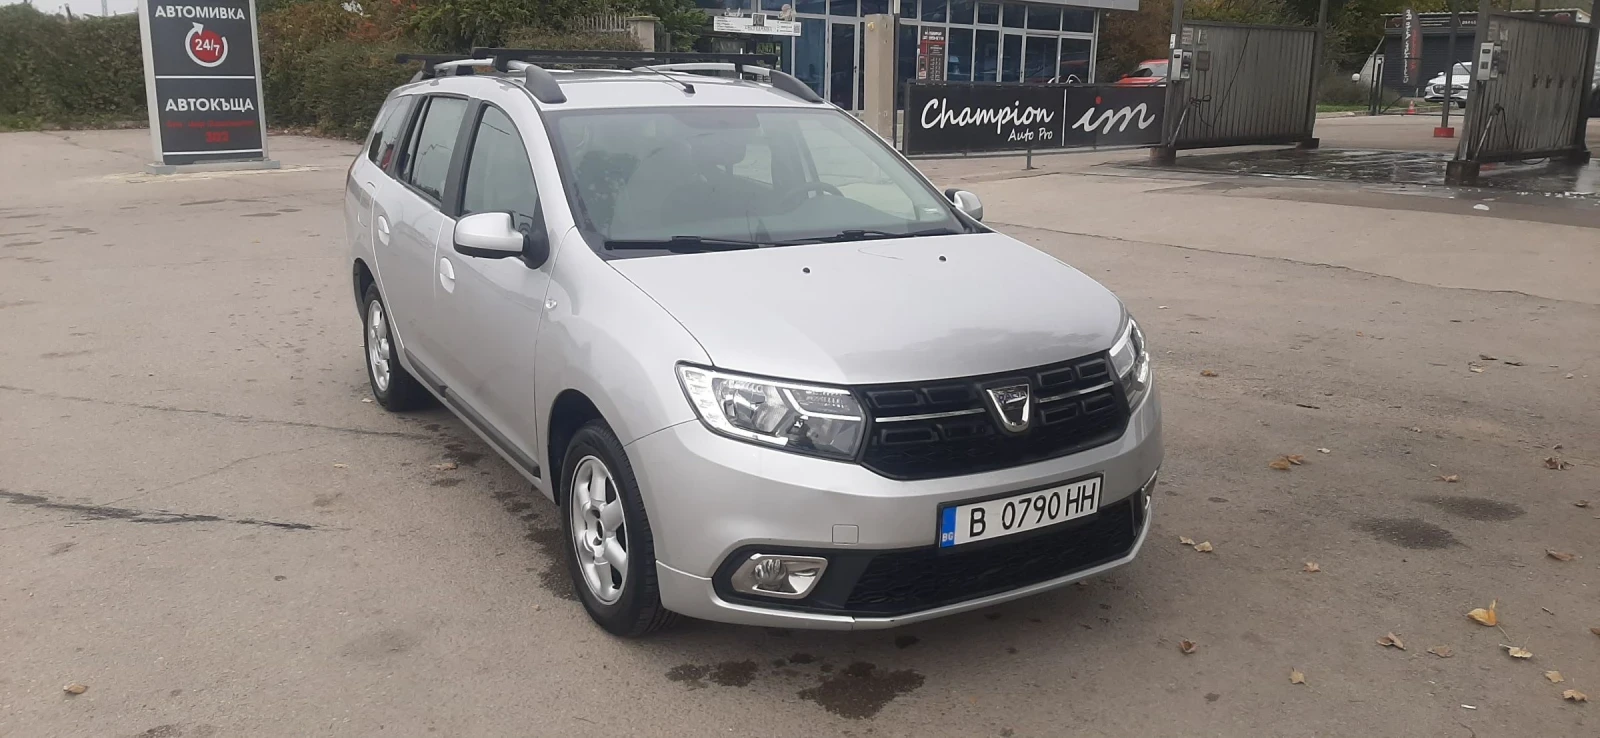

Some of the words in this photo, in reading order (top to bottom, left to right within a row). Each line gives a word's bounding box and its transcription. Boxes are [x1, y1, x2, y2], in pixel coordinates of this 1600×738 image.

[155, 5, 246, 20] АВТОМИВКА
[195, 38, 220, 57] 24/7
[165, 97, 255, 113] АВТОКЪЩА
[921, 98, 1055, 135] Champion
[1008, 128, 1034, 142] Auto
[1039, 127, 1053, 142] Pro
[969, 507, 986, 538] B
[1001, 491, 1061, 531] 0790
[1065, 482, 1096, 517] HH
[942, 531, 954, 542] BG
